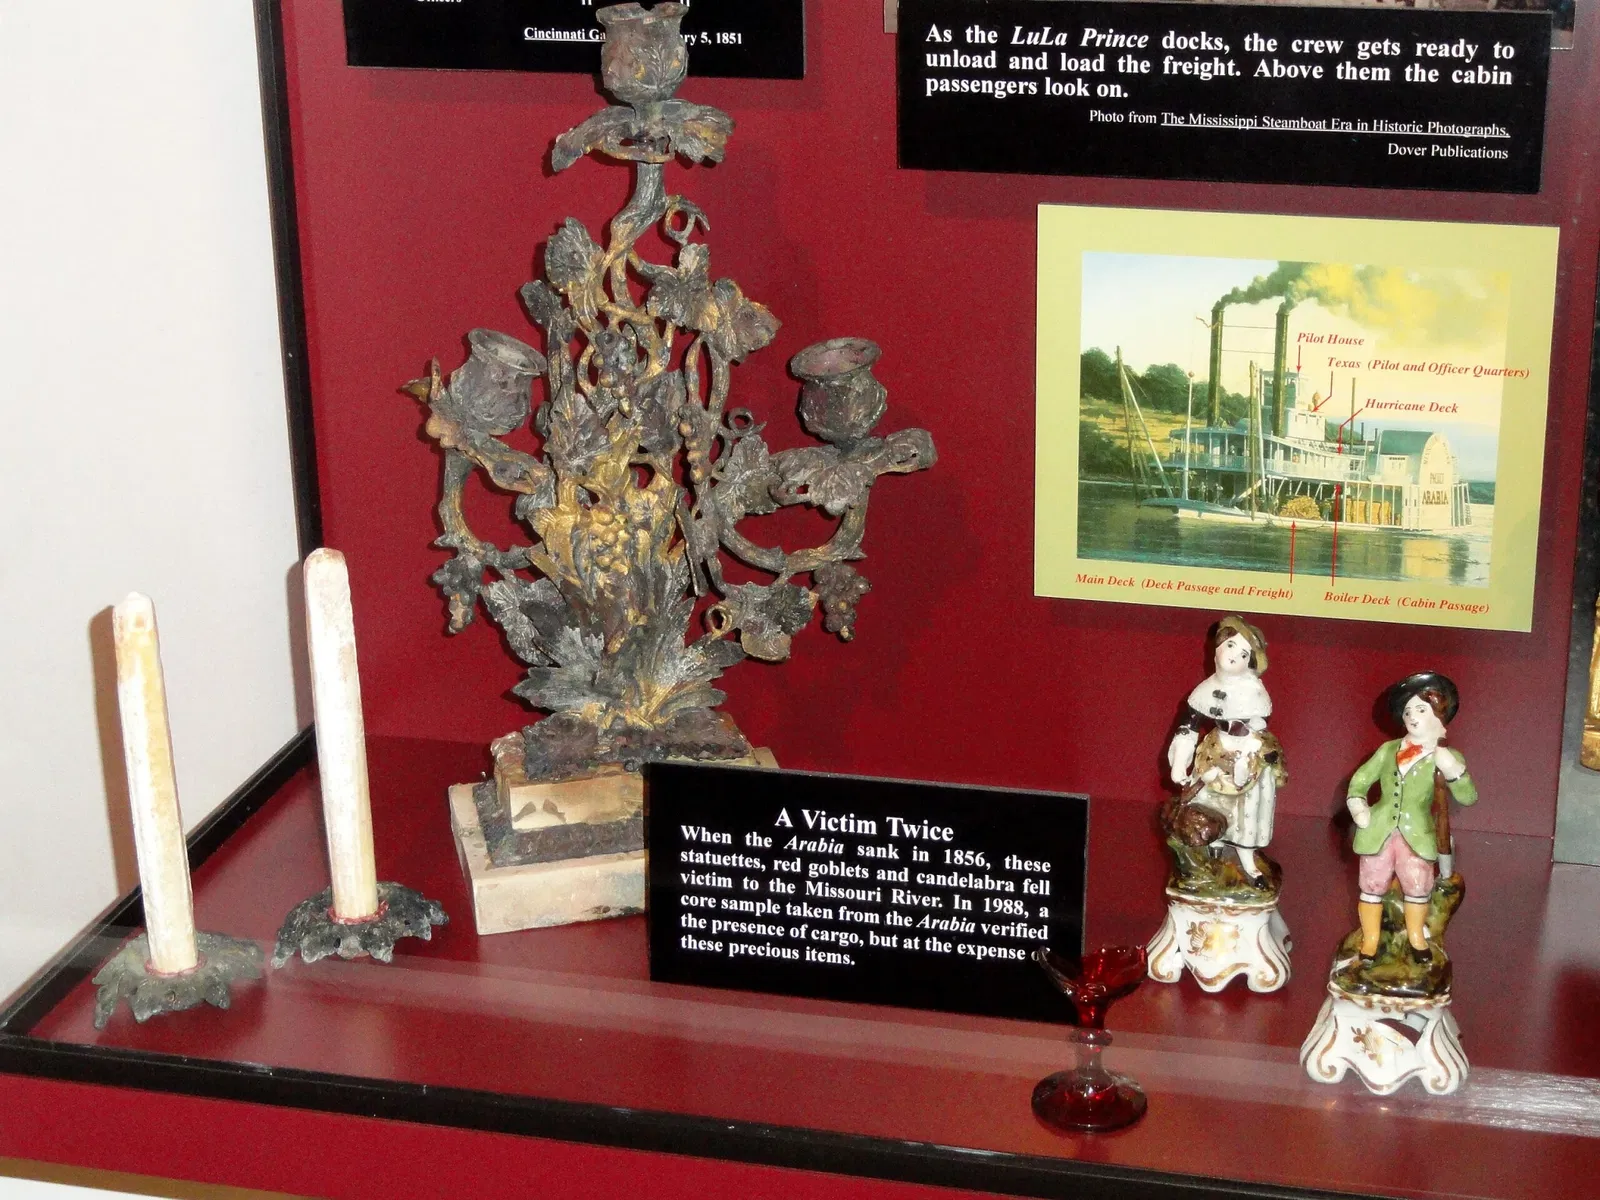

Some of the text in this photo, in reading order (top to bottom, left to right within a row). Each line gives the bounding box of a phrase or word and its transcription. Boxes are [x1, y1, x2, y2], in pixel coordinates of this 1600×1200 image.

[524, 27, 585, 41] Cincinnati
[701, 32, 711, 44] 5,
[717, 33, 741, 44] 1851
[926, 24, 1514, 63] As the LuLa Prince docks, the crew gets ready to
[926, 49, 1512, 85] unload and load the freight. Above them the cabin
[926, 77, 1128, 98] passengers look on.
[1090, 110, 1509, 138] Photo from The Mississippi Steamboat Era in Historic Photographs.
[1388, 143, 1508, 159] Dover Publications
[1297, 332, 1364, 346] Pilot House
[1328, 357, 1531, 379] Texas (Pilot and Officer Quarters)
[1365, 398, 1459, 414] Hurricane Deck
[1075, 573, 1294, 601] Main Deck (Deck Passage and Freight)
[1324, 591, 1491, 615] Boiler Deck (Cabin Passage)
[775, 808, 953, 841] A Victim Twice
[681, 825, 1051, 872] When the Arabia sank in 1856, these
[681, 849, 1050, 895] statuettes, red goblets and candelabra fell
[681, 870, 1049, 918] victim to the Missouri River. In 1988, a
[681, 895, 1048, 940] core sample taken from the Arabia verified
[681, 913, 707, 928] the
[712, 920, 784, 936] presence
[790, 924, 808, 938] of
[811, 930, 864, 947] cargo,
[870, 931, 898, 947] but
[903, 937, 920, 950] at
[925, 937, 952, 953] the
[957, 944, 1025, 960] expense
[681, 935, 855, 965] these precious items.
